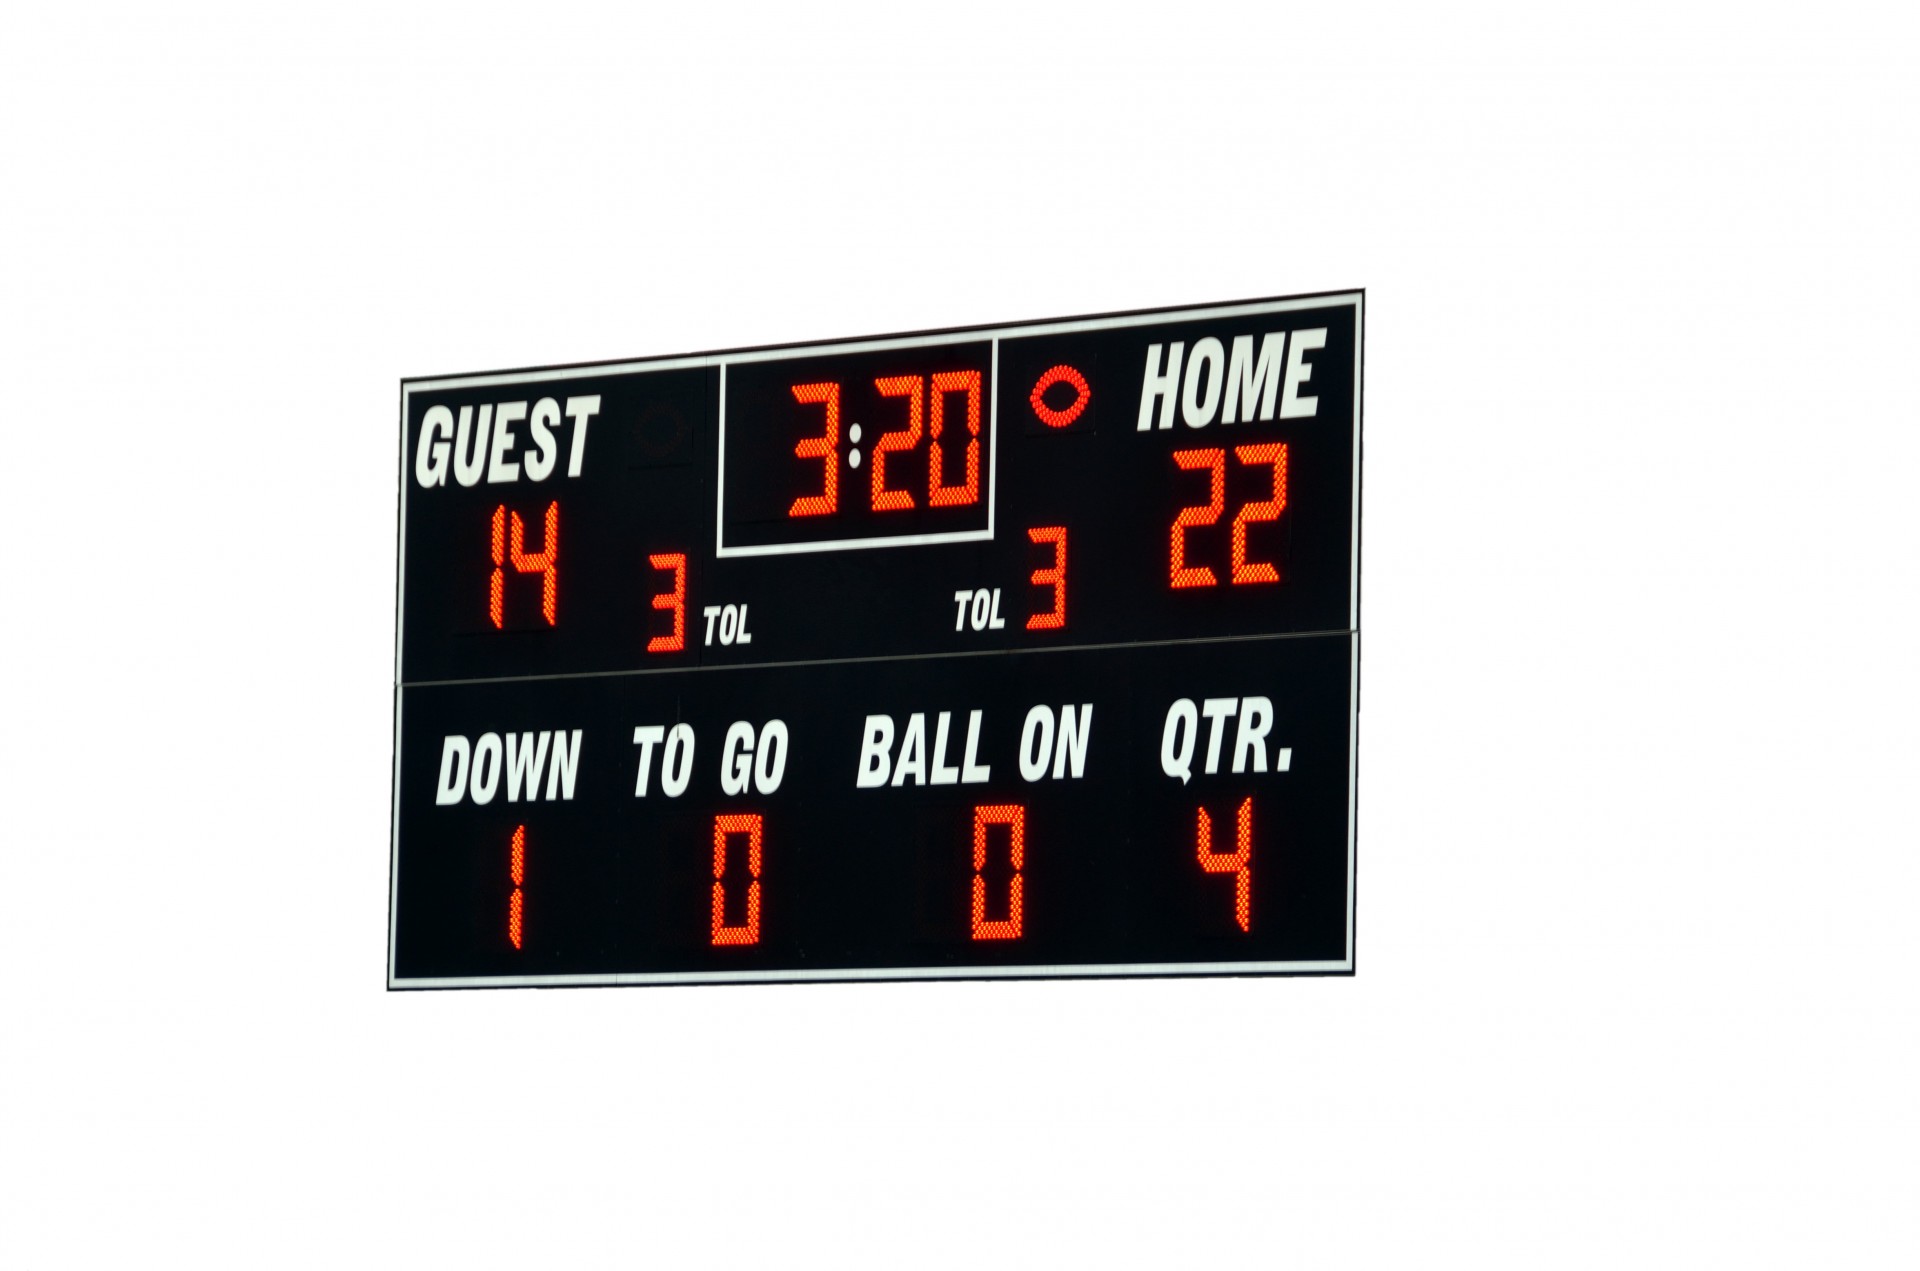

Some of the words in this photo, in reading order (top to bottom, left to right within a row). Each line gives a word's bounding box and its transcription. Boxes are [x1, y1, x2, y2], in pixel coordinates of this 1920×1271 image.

[1136, 327, 1328, 432] HOME
[415, 394, 601, 489] GUEST
[788, 370, 982, 518] 3:20
[489, 500, 560, 630] 14
[1169, 441, 1289, 590] 22
[646, 552, 687, 653] 3
[703, 603, 752, 646] TOL
[954, 588, 1006, 632] TOL
[1025, 525, 1068, 631] 3
[435, 730, 583, 806] DOWN
[632, 722, 696, 798] TO
[720, 719, 789, 796] GO
[856, 709, 991, 789] BALL
[1018, 703, 1094, 782] ON
[1160, 696, 1292, 786] QTR.
[508, 824, 526, 950] 1
[710, 813, 764, 947] 0
[970, 803, 1026, 941] 0
[1195, 796, 1253, 933] 4
